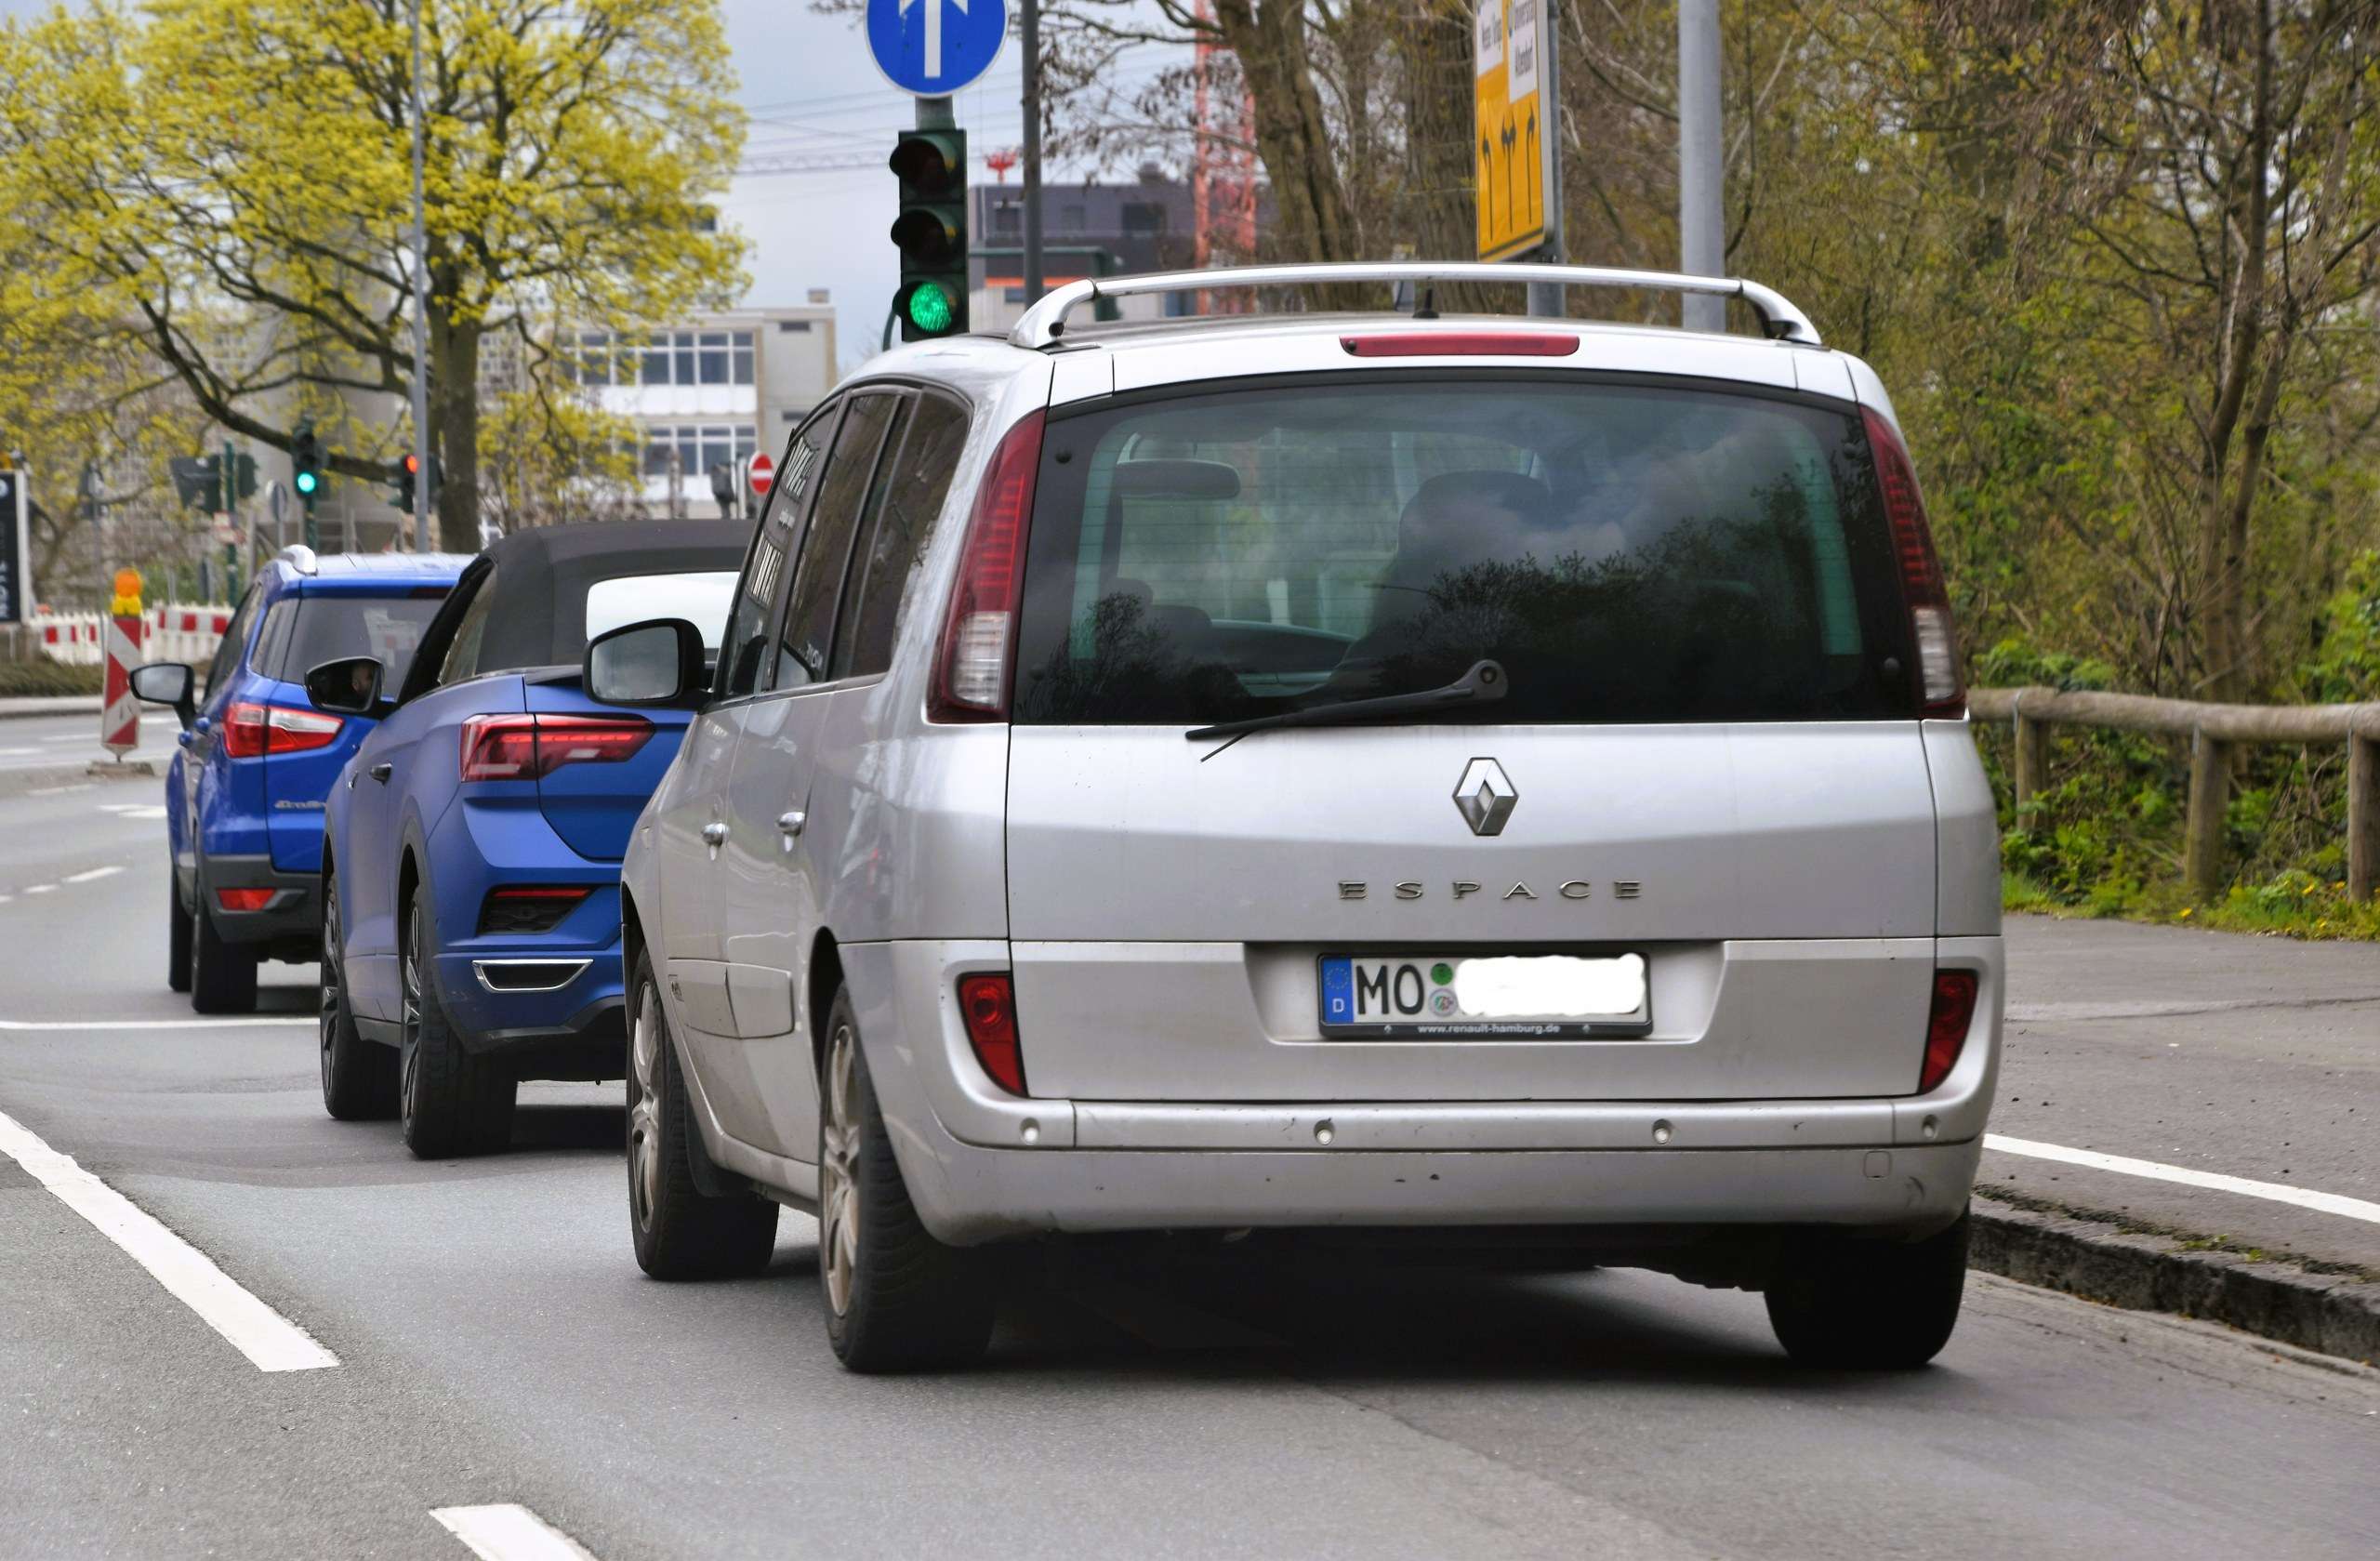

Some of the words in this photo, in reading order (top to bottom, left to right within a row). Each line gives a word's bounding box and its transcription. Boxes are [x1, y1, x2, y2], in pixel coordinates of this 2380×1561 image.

[1338, 880, 1642, 900] ESPACE
[1332, 998, 1344, 1012] D
[1356, 964, 1425, 1014] MO
[1417, 1023, 1561, 1035] www.renault-hamburg.de
